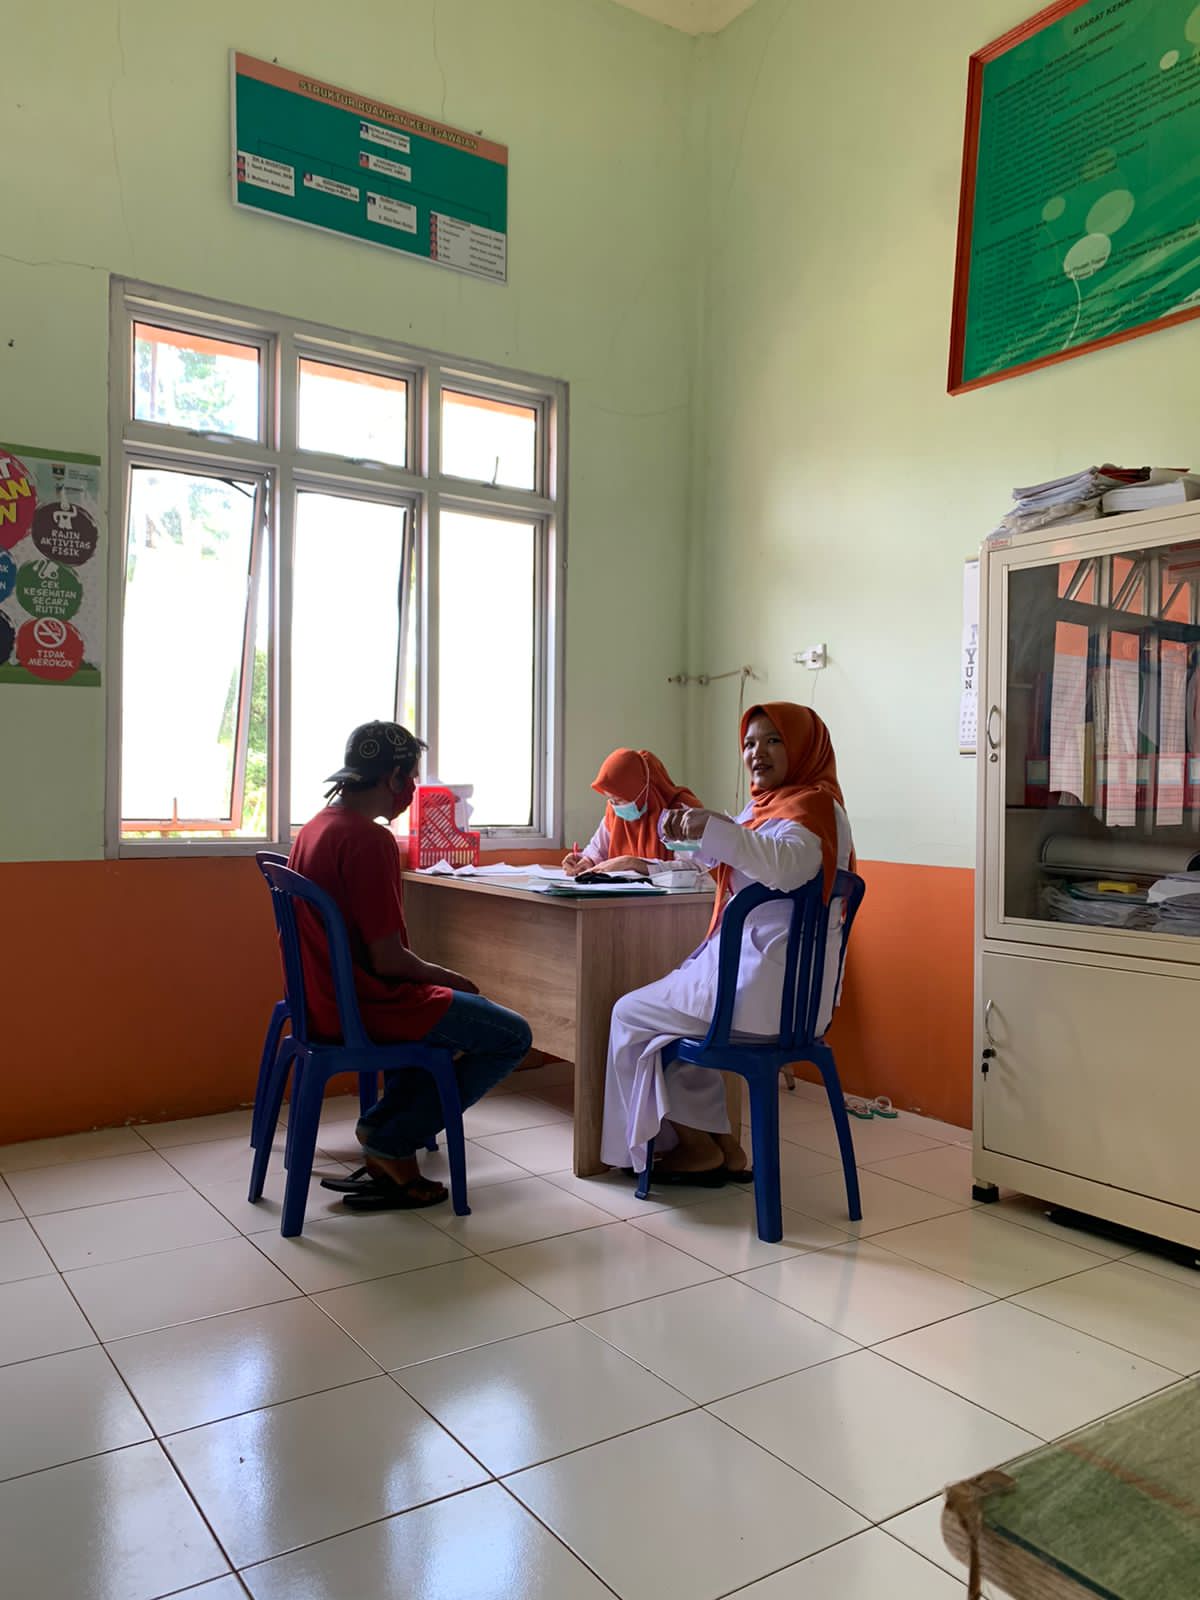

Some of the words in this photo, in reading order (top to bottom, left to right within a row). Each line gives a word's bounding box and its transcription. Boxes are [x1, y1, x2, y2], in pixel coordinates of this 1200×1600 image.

[299, 80, 354, 107] STRUKTUR
[358, 100, 407, 126] RUANGAN
[52, 529, 81, 540] RAJIN
[40, 537, 91, 550] AKTIVITAS
[52, 547, 80, 557] FISIK
[41, 580, 60, 589] CEK
[23, 587, 77, 600] KESEHATAN
[32, 597, 69, 606] SECARA
[35, 605, 66, 615] RUTIN
[37, 649, 65, 658] TIDAK
[28, 658, 73, 668] MEROKOK
